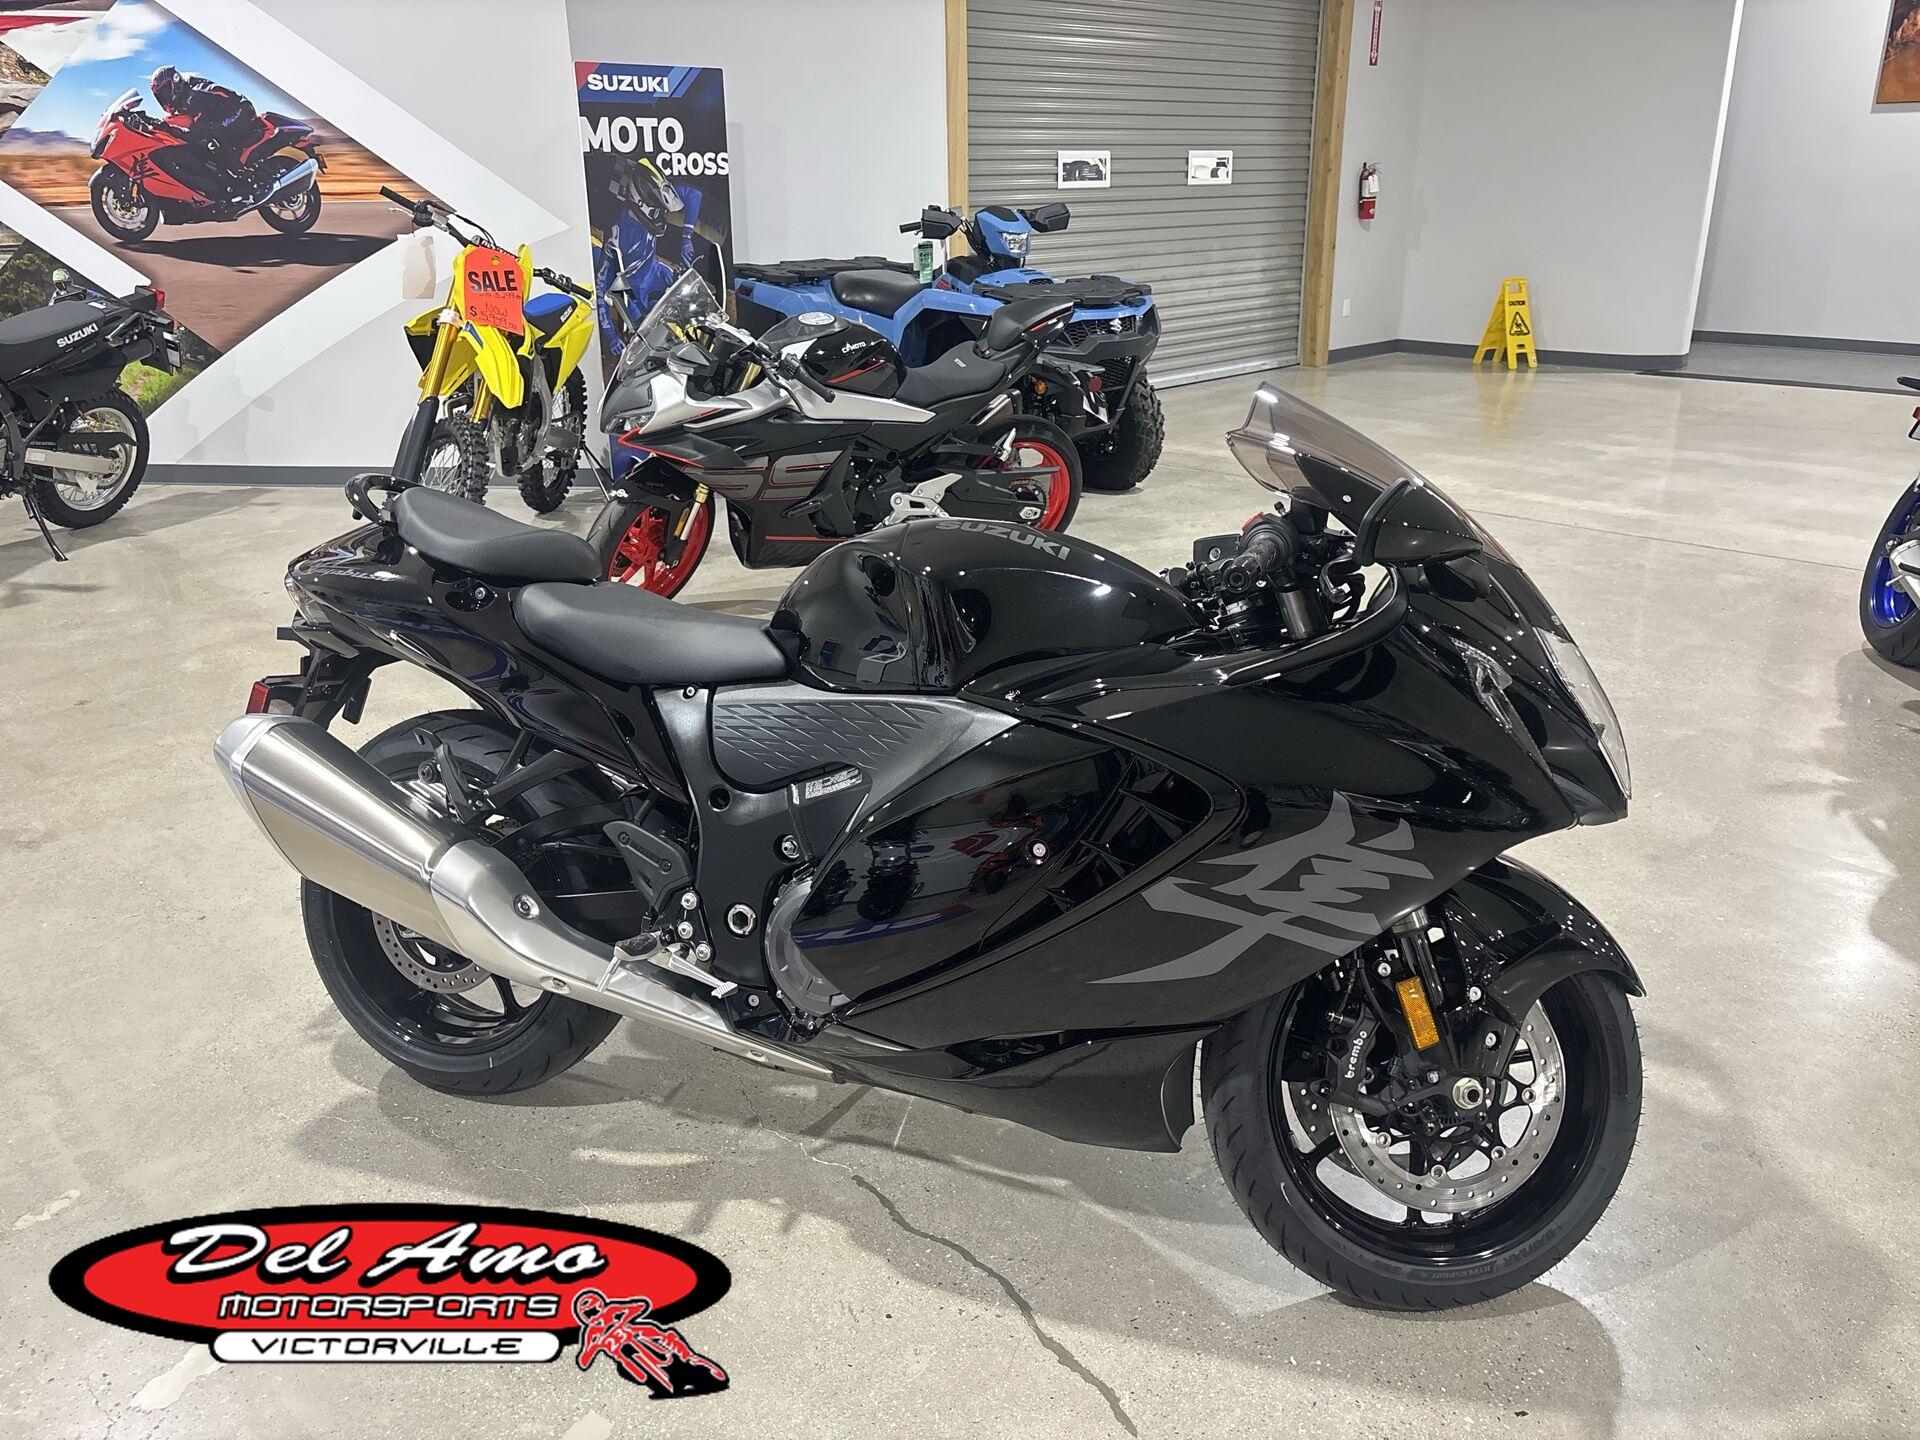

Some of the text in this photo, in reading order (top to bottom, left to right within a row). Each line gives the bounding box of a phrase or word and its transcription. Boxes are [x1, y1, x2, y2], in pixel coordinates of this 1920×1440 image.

[587, 73, 669, 93] SUZUKI
[580, 116, 684, 153] MOTO
[656, 152, 730, 176] CROSS
[467, 269, 518, 292] SALE
[56, 322, 99, 348] SUZUKI
[935, 521, 1071, 561] SUZUKI
[1344, 1030, 1368, 1079] brembo
